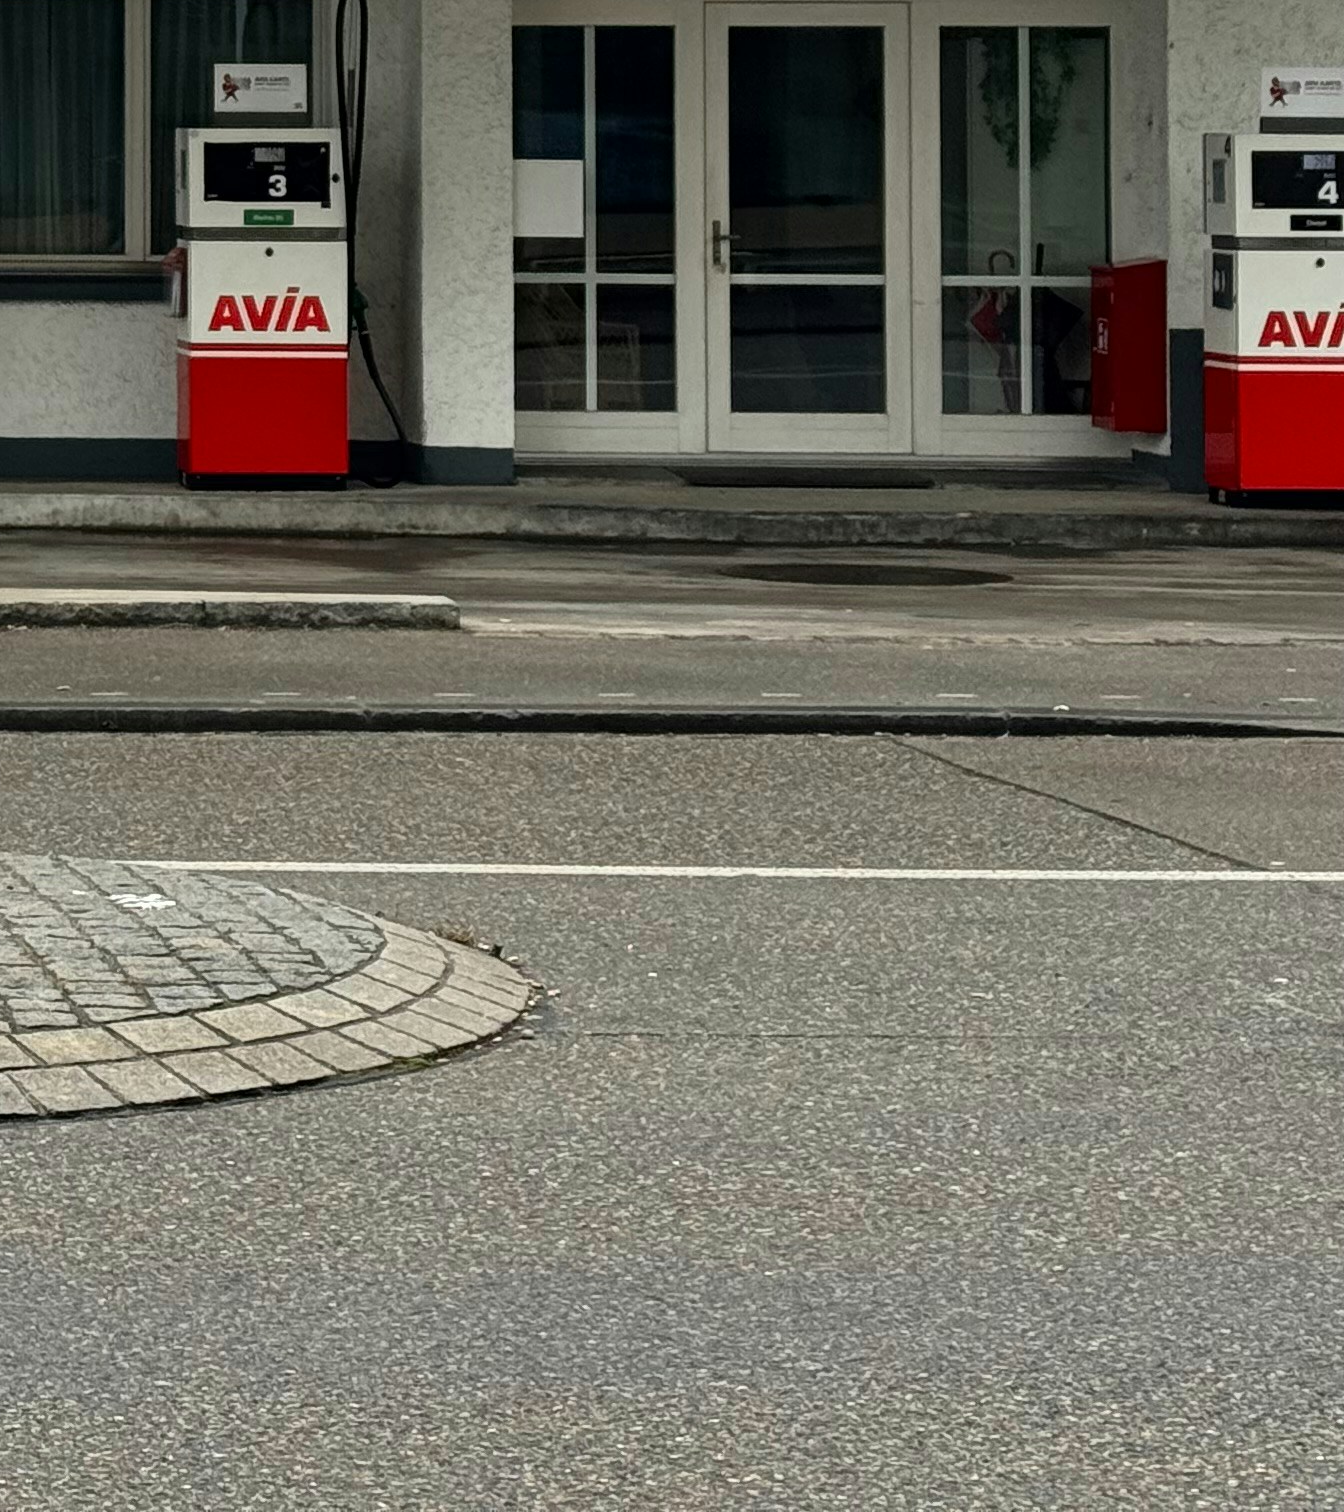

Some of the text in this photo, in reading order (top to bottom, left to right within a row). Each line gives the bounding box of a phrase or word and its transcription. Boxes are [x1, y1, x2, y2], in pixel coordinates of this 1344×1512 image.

[268, 174, 288, 197] 3
[1317, 180, 1339, 204] 4
[207, 287, 330, 332] AVIA
[1257, 302, 1344, 347] AVI
